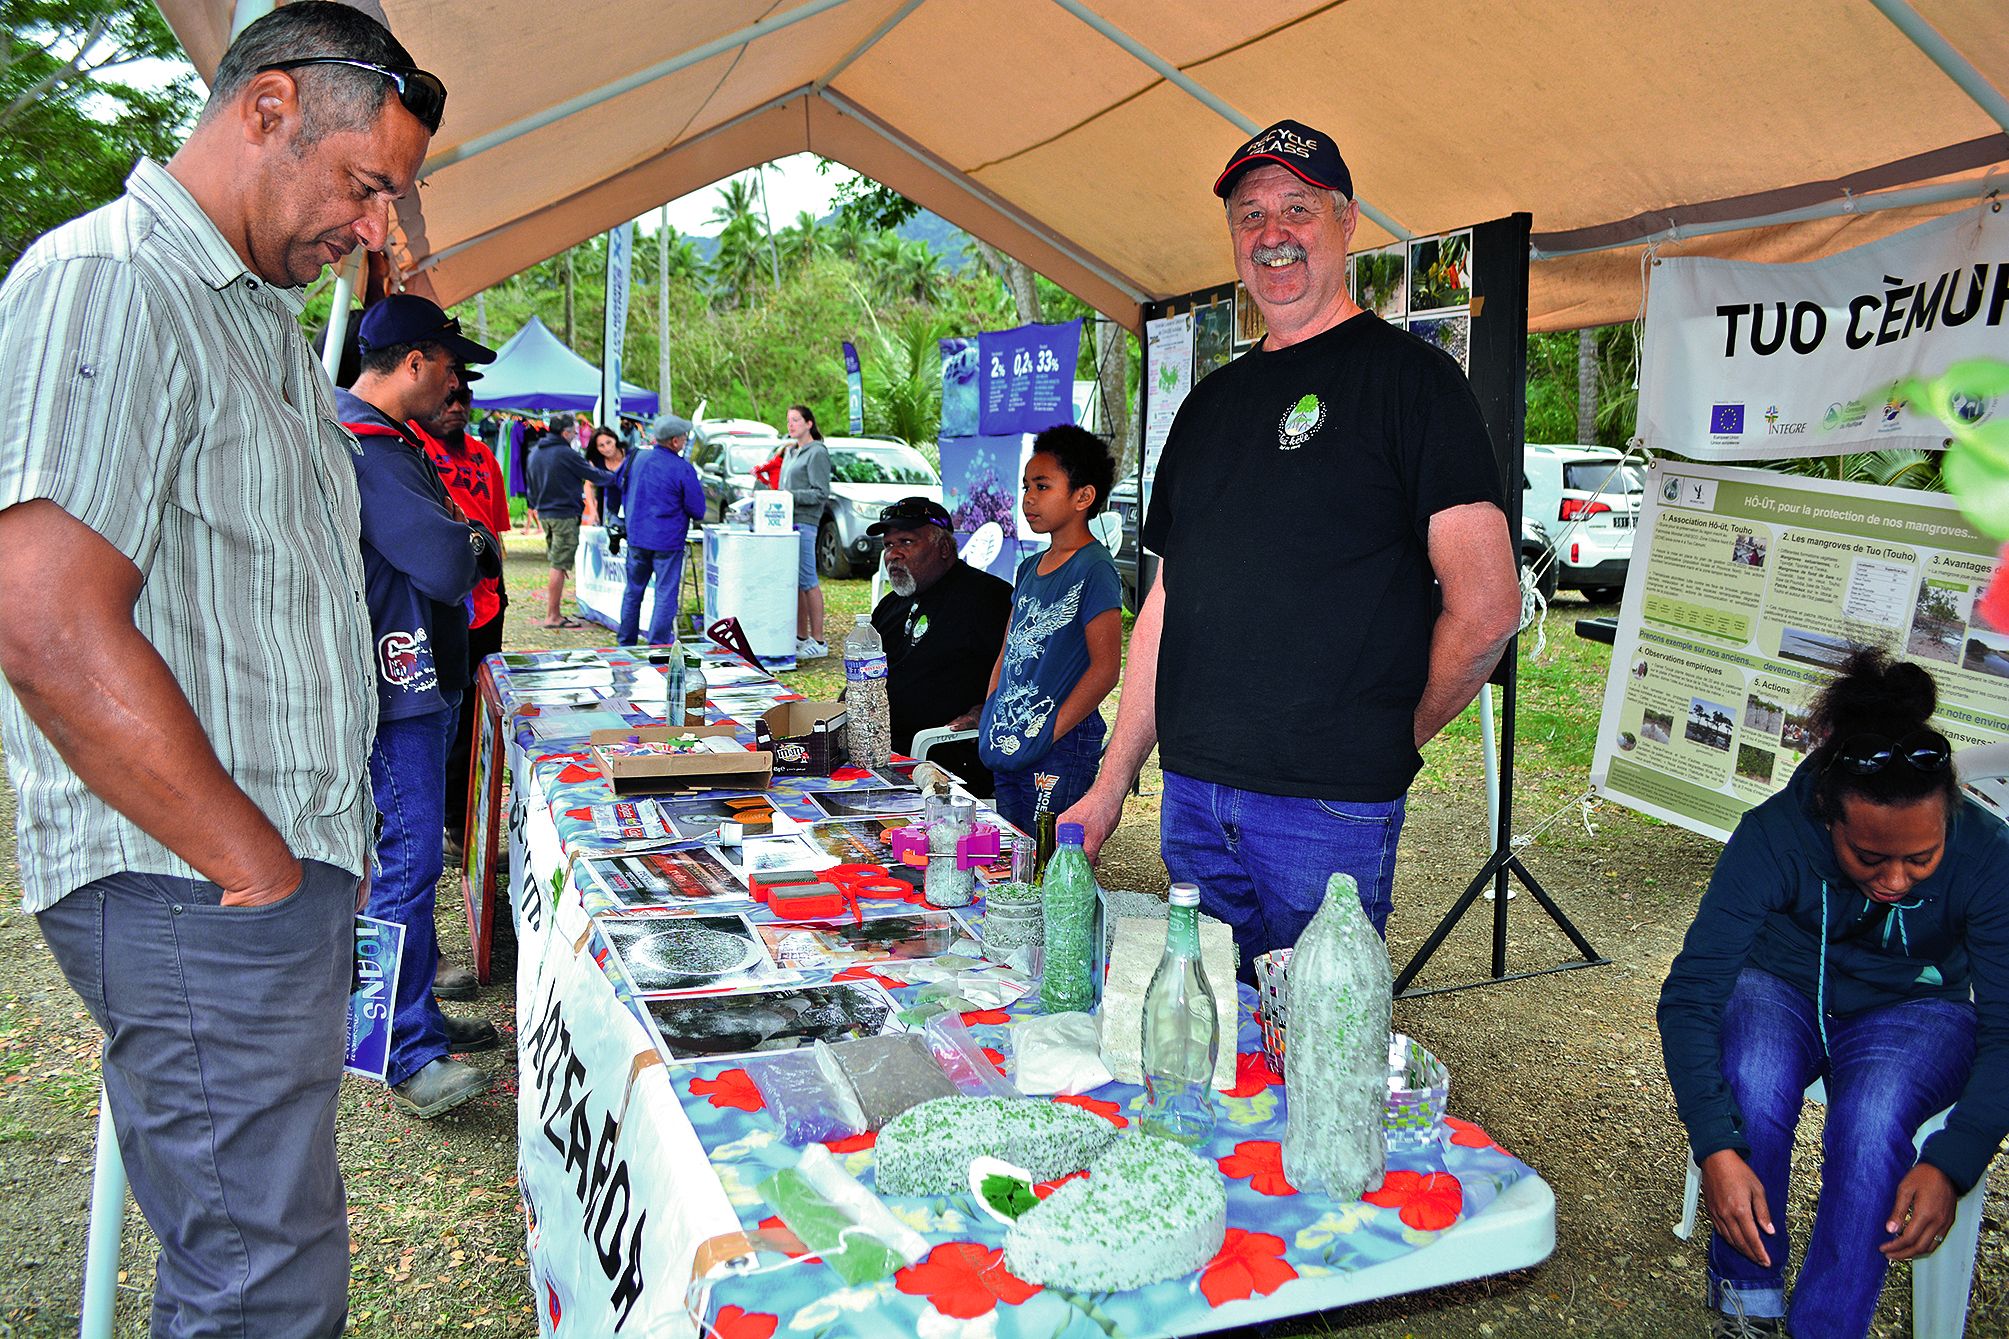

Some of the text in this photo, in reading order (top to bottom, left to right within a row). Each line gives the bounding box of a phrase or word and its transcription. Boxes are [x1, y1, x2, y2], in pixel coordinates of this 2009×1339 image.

[1246, 128, 1318, 152] RECYCLE
[1248, 140, 1310, 159] GLASS
[1715, 300, 1827, 358] TUO
[1036, 349, 1059, 373] 33%
[1768, 422, 1807, 435] INTEGRE
[1668, 515, 1707, 528] Association
[1731, 524, 1753, 535] Touho
[1777, 502, 1800, 515] pour
[1802, 504, 1811, 515] la
[1812, 507, 1865, 523] protection
[1866, 513, 1881, 525] de
[1882, 517, 1903, 529] nos
[1905, 520, 1978, 540] mangroves...
[1783, 533, 1917, 564] 2. Les mangroves de Tuo (Touho)
[1933, 556, 1940, 565] 3.
[1942, 557, 1992, 573] Avantages
[1638, 647, 1723, 675] 4. Observations empiriques
[1640, 631, 1664, 644] Prenons
[1665, 637, 1693, 651] exemple
[1694, 645, 1706, 654] sur
[1706, 648, 1720, 657] nos
[1720, 652, 1756, 667] anciens...
[1763, 662, 1800, 678] devenons
[1754, 679, 1791, 695] 5. Actions
[1946, 709, 1973, 722] notre
[356, 925, 388, 1020] 10 ANS
